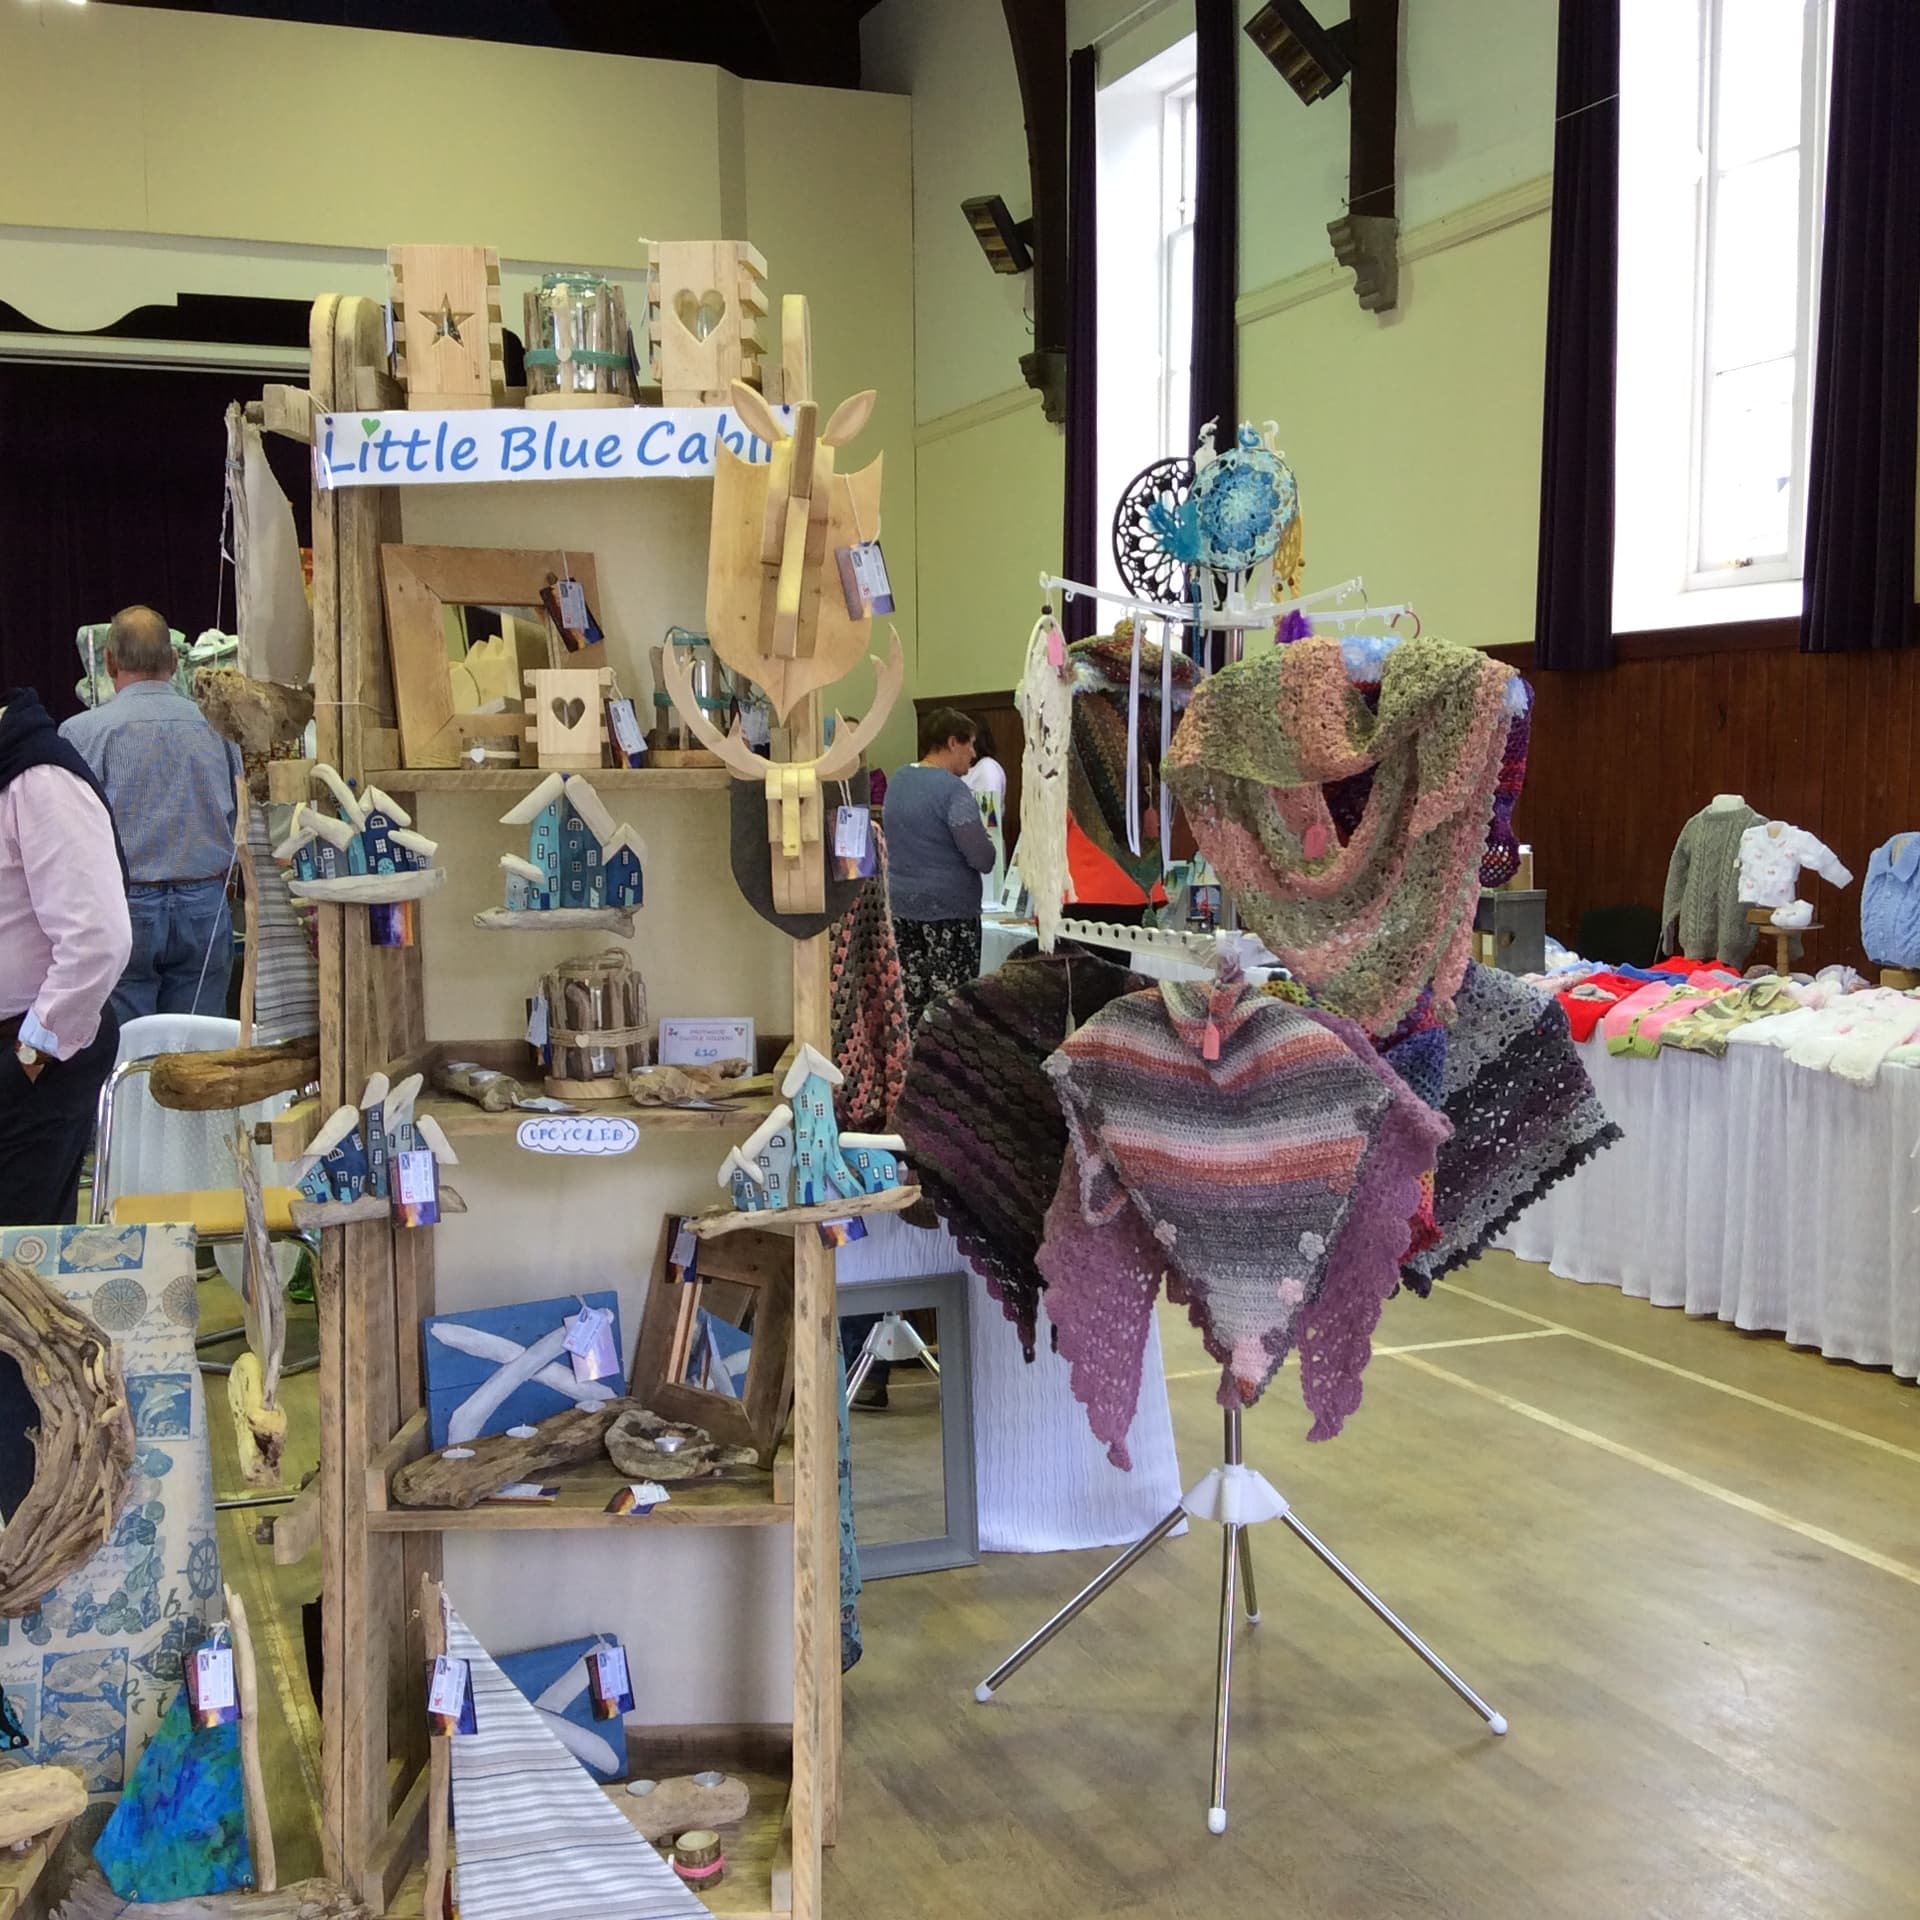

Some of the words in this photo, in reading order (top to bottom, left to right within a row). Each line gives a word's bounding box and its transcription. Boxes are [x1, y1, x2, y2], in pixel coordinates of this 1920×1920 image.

[323, 418, 479, 474] Little
[500, 420, 624, 472] Blue
[637, 412, 772, 467] Cabi
[530, 1127, 623, 1141] UPCYCLED
